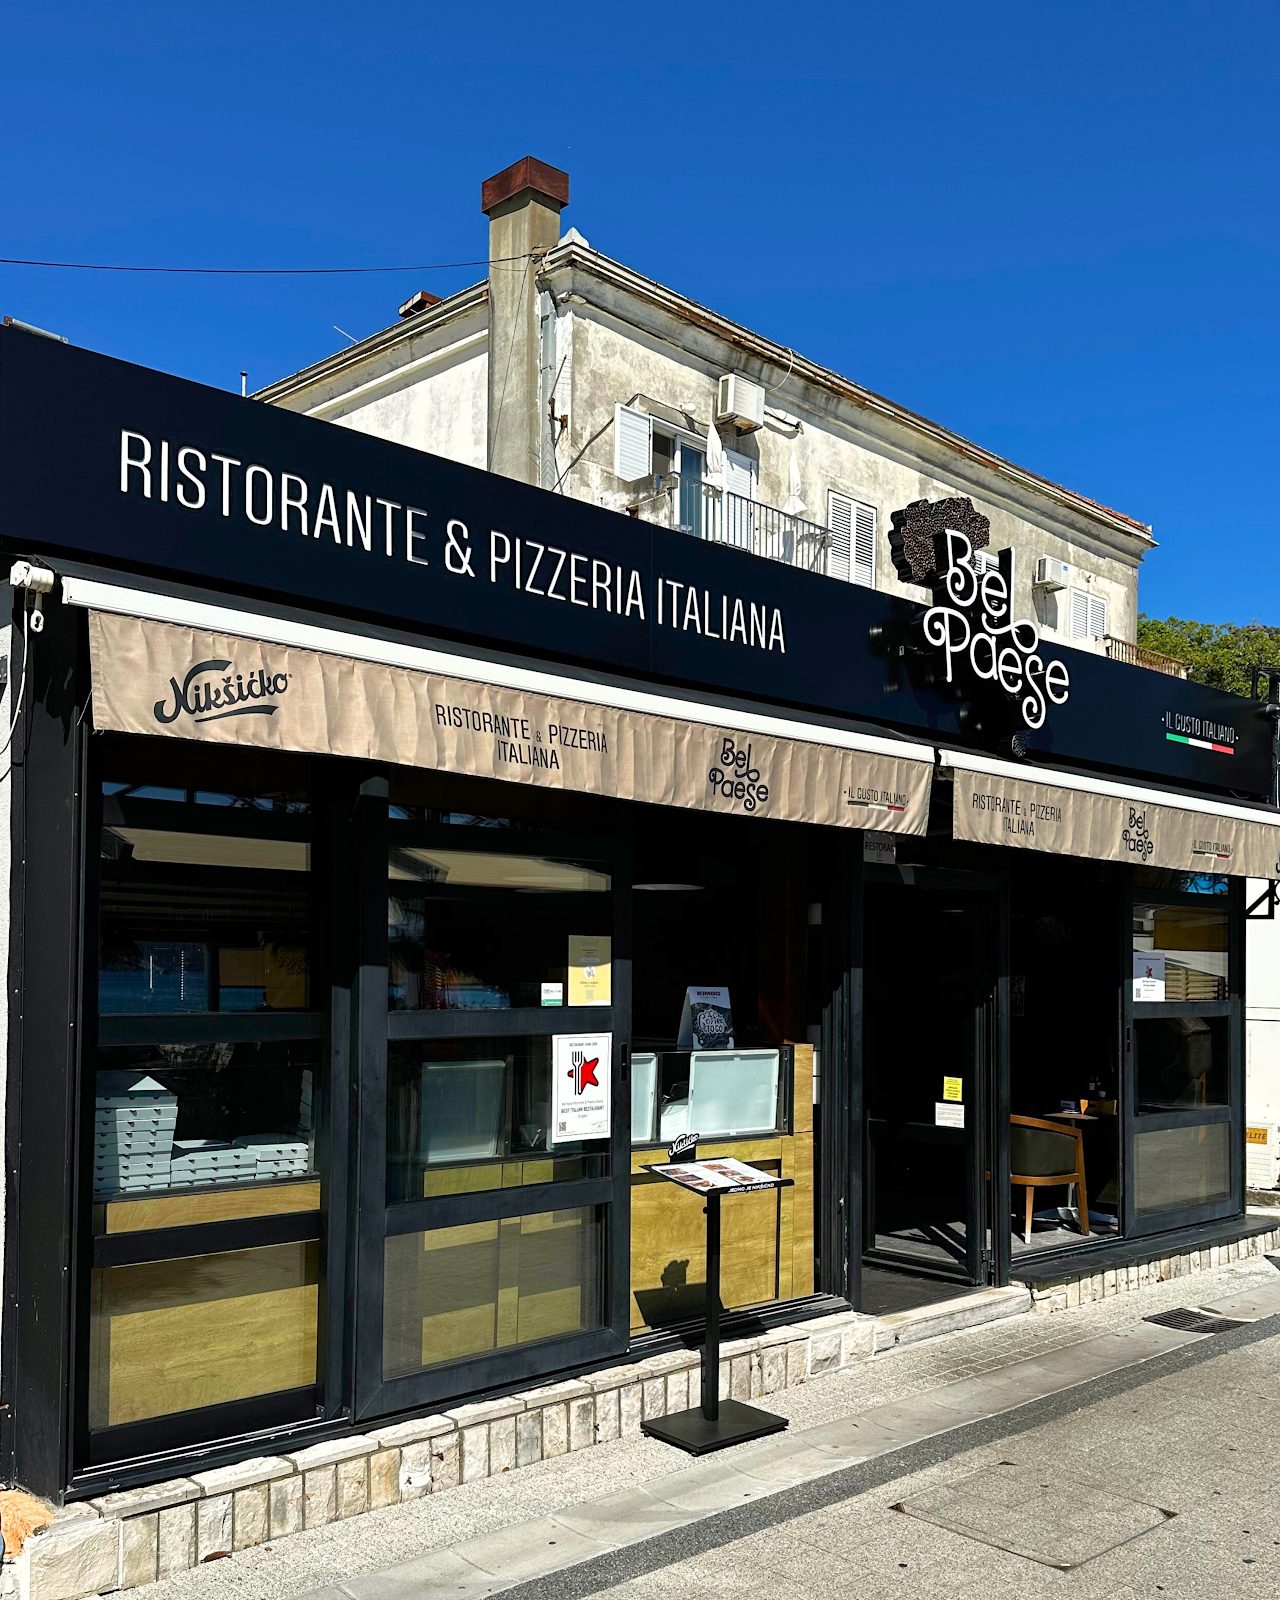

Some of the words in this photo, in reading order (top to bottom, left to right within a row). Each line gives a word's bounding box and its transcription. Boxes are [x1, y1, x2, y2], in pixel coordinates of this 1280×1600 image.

[120, 428, 429, 567] RISTORANTE
[444, 518, 476, 578] &
[490, 529, 646, 620] PIZZERIA
[657, 576, 786, 654] ITALIANA
[944, 529, 1039, 654] Bel
[923, 606, 1070, 729] Paese
[154, 659, 288, 724] Nikšićko
[435, 704, 531, 740] RISTORANTE
[535, 731, 542, 743] &
[549, 724, 608, 754] PIZZERIA
[1165, 711, 1174, 729] IL
[1175, 713, 1201, 735] GUSTO
[1202, 720, 1235, 744] ITALIANO
[497, 740, 560, 769] ITALIANA
[720, 737, 760, 782] Bel
[709, 767, 769, 811] Paese
[848, 786, 855, 799] IL
[857, 787, 879, 802] GUSTO
[880, 790, 907, 806] ITALIANO
[972, 793, 1021, 815] RISTORANTE
[1030, 803, 1062, 822] PIZZERIA
[1128, 807, 1149, 839] Bel
[1003, 817, 1035, 836] ITALIANA
[1122, 829, 1154, 861] Paese
[1198, 840, 1212, 851] GUSTO
[1213, 842, 1230, 853] ITALIANO
